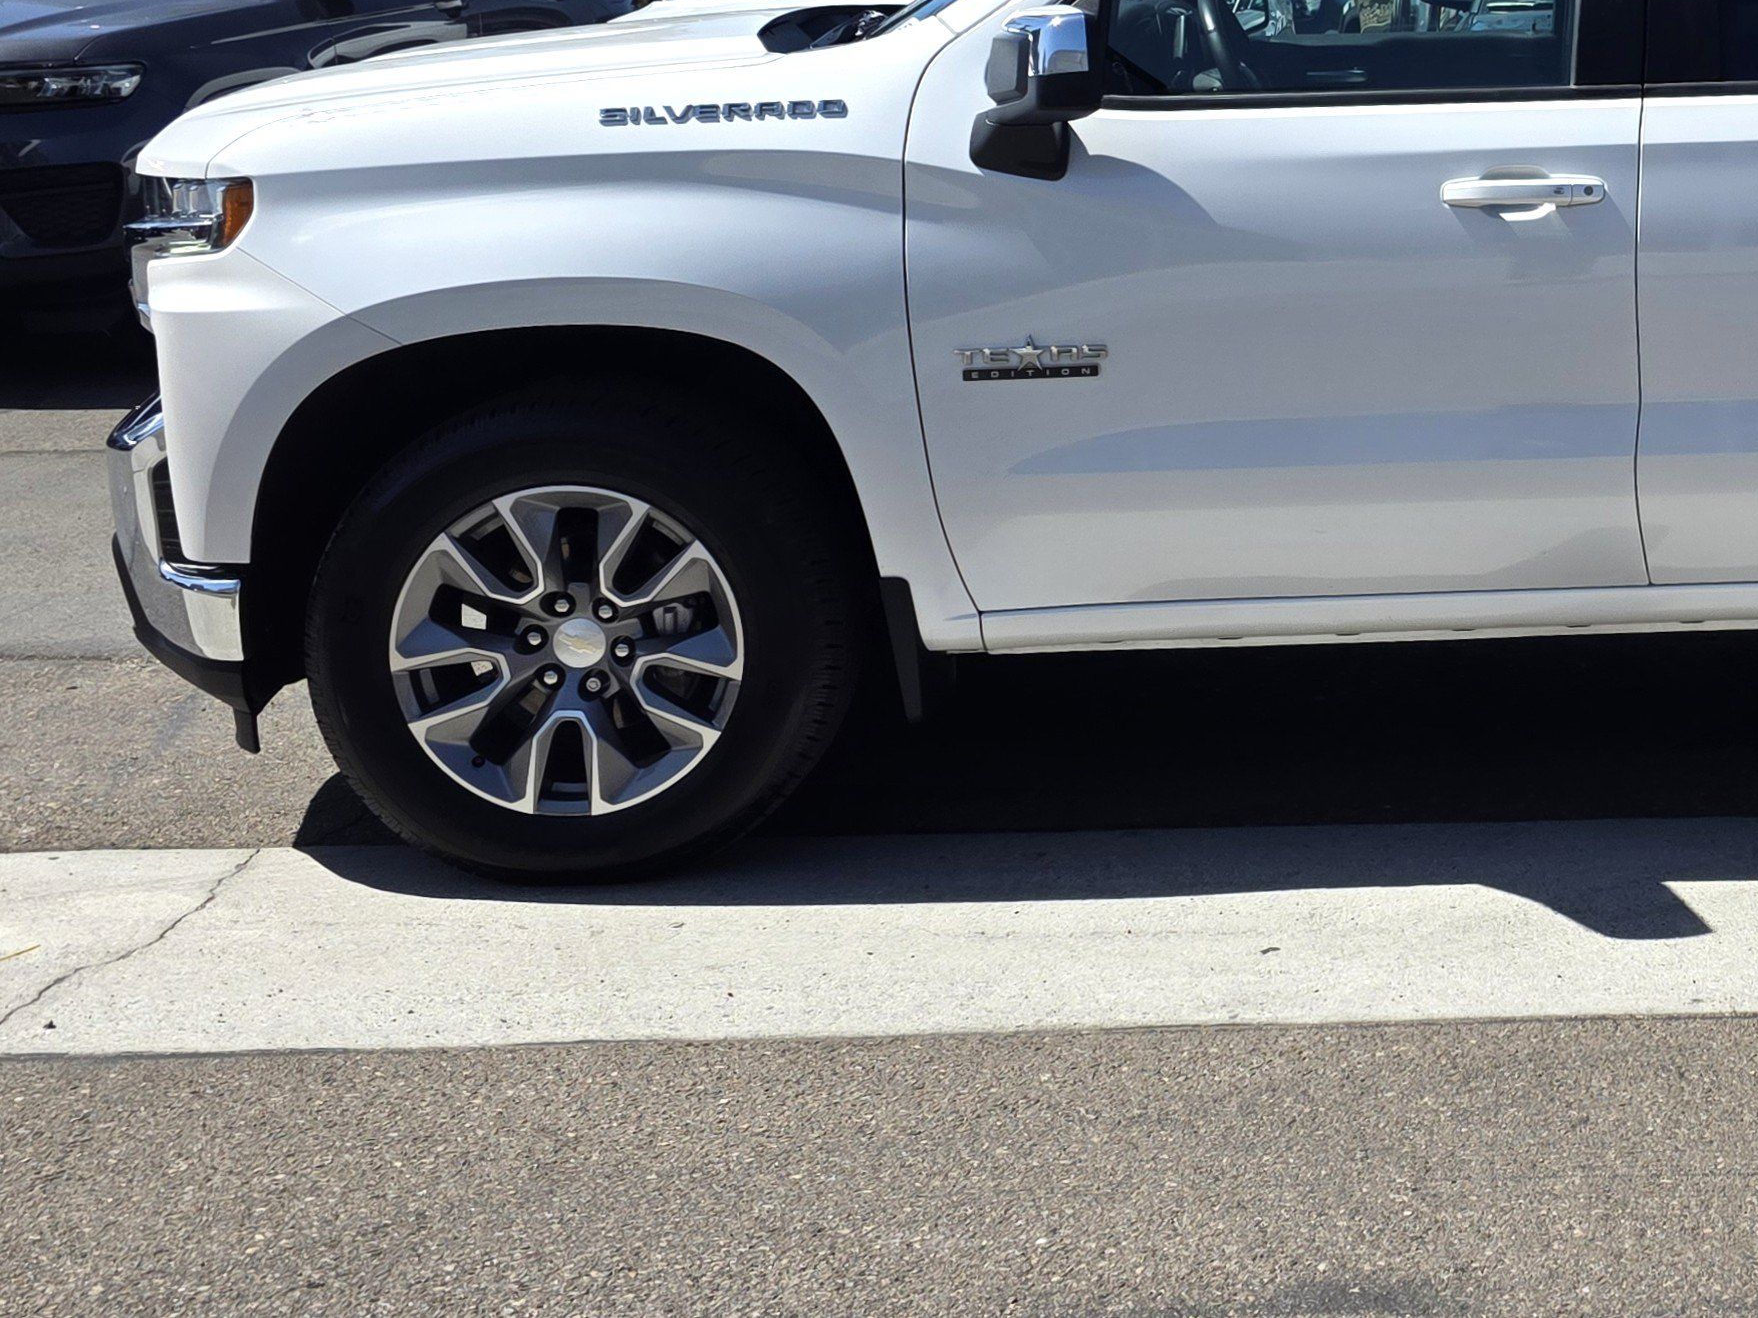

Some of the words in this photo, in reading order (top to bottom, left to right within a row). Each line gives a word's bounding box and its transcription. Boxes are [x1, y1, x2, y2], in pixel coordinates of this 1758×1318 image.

[599, 98, 849, 127] SILVERADO
[953, 336, 1109, 369] TEXAS
[970, 367, 1092, 380] EDITION
